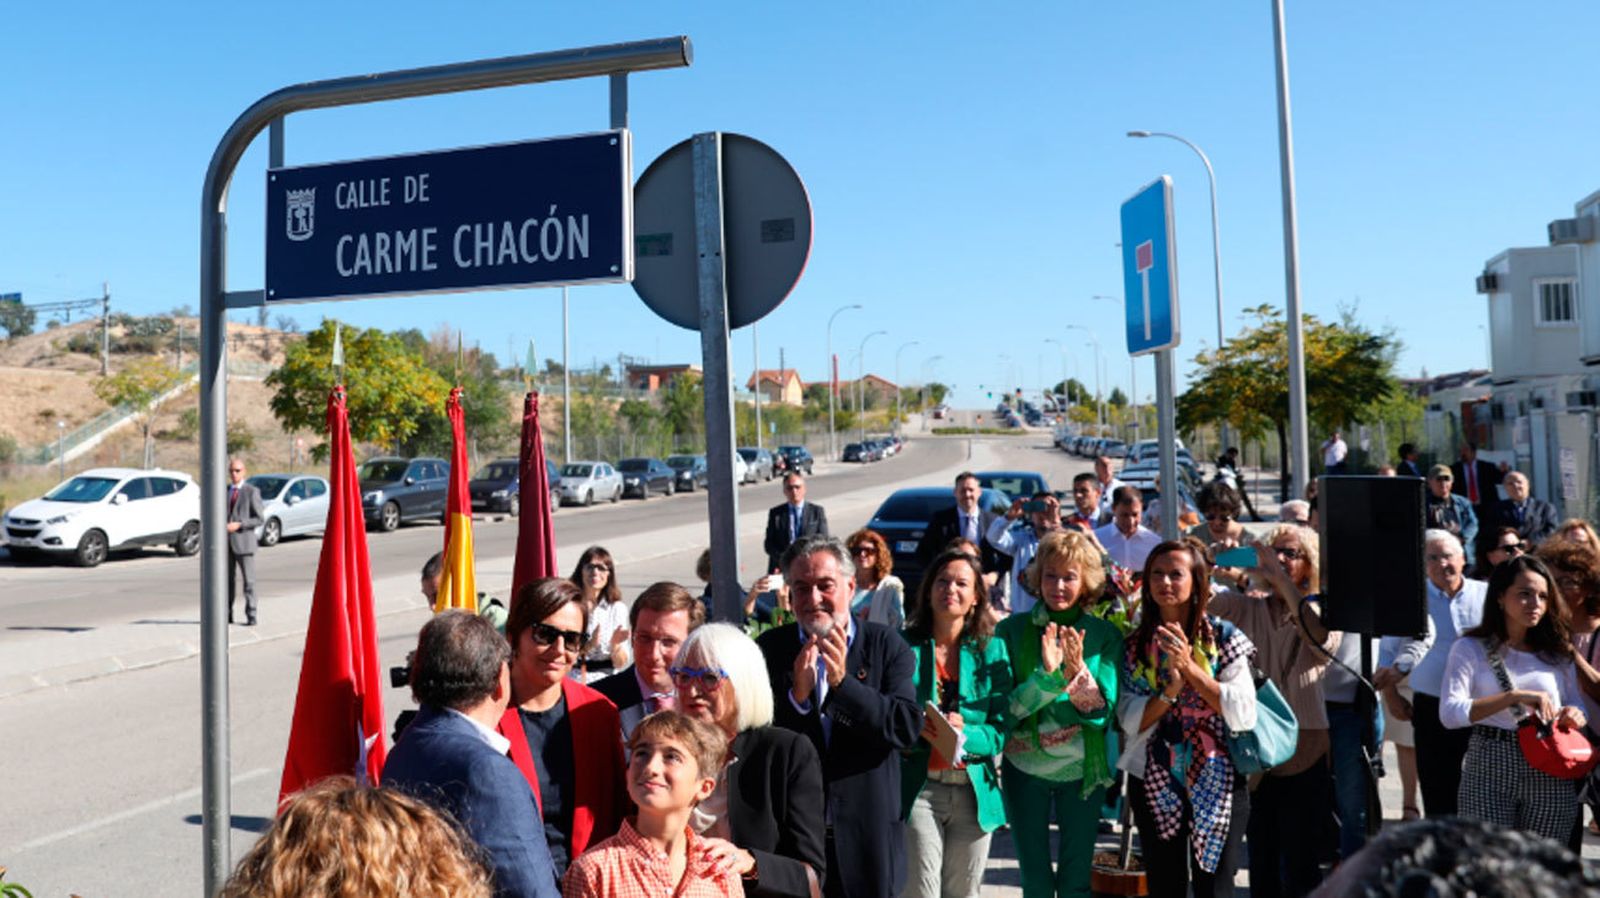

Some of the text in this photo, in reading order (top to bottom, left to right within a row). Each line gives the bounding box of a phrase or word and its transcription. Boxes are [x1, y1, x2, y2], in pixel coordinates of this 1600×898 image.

[336, 173, 430, 209] CALLE DE
[336, 227, 438, 277] CARME
[453, 204, 590, 267] CHACÓN
